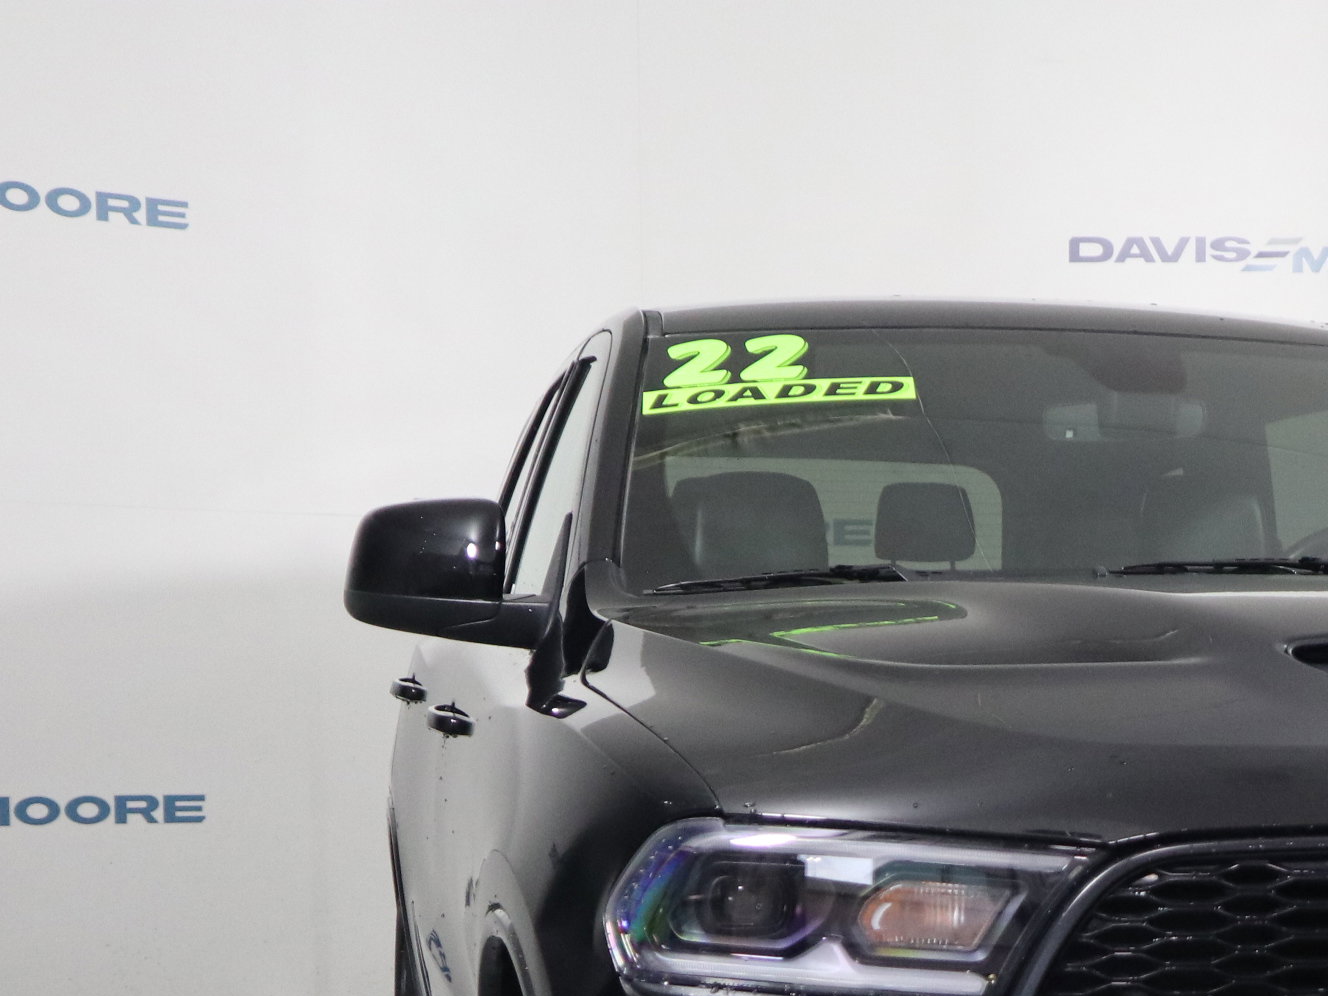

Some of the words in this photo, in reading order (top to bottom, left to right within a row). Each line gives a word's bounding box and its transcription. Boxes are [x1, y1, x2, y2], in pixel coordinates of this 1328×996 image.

[1068, 235, 1252, 264] DAVIS
[663, 334, 809, 389] 22
[648, 380, 905, 411] LOADED
[0, 794, 206, 827] OORE
